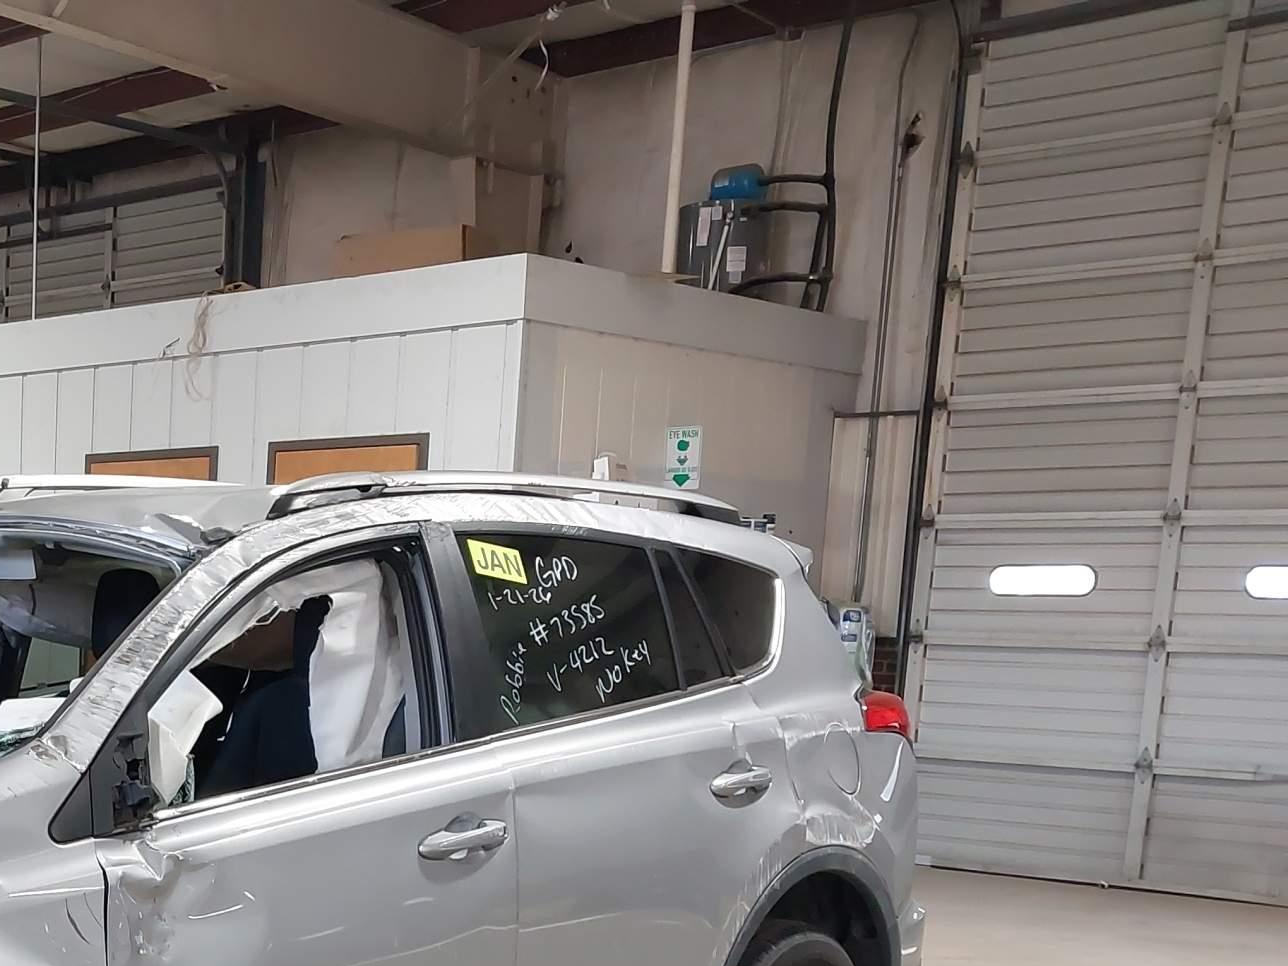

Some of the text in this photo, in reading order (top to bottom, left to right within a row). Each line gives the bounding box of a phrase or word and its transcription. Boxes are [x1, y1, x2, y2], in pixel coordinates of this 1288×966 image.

[669, 429, 698, 440] EYE WASH
[476, 548, 522, 577] JAN
[535, 556, 577, 589] GPD
[488, 586, 553, 611] 1-21-26
